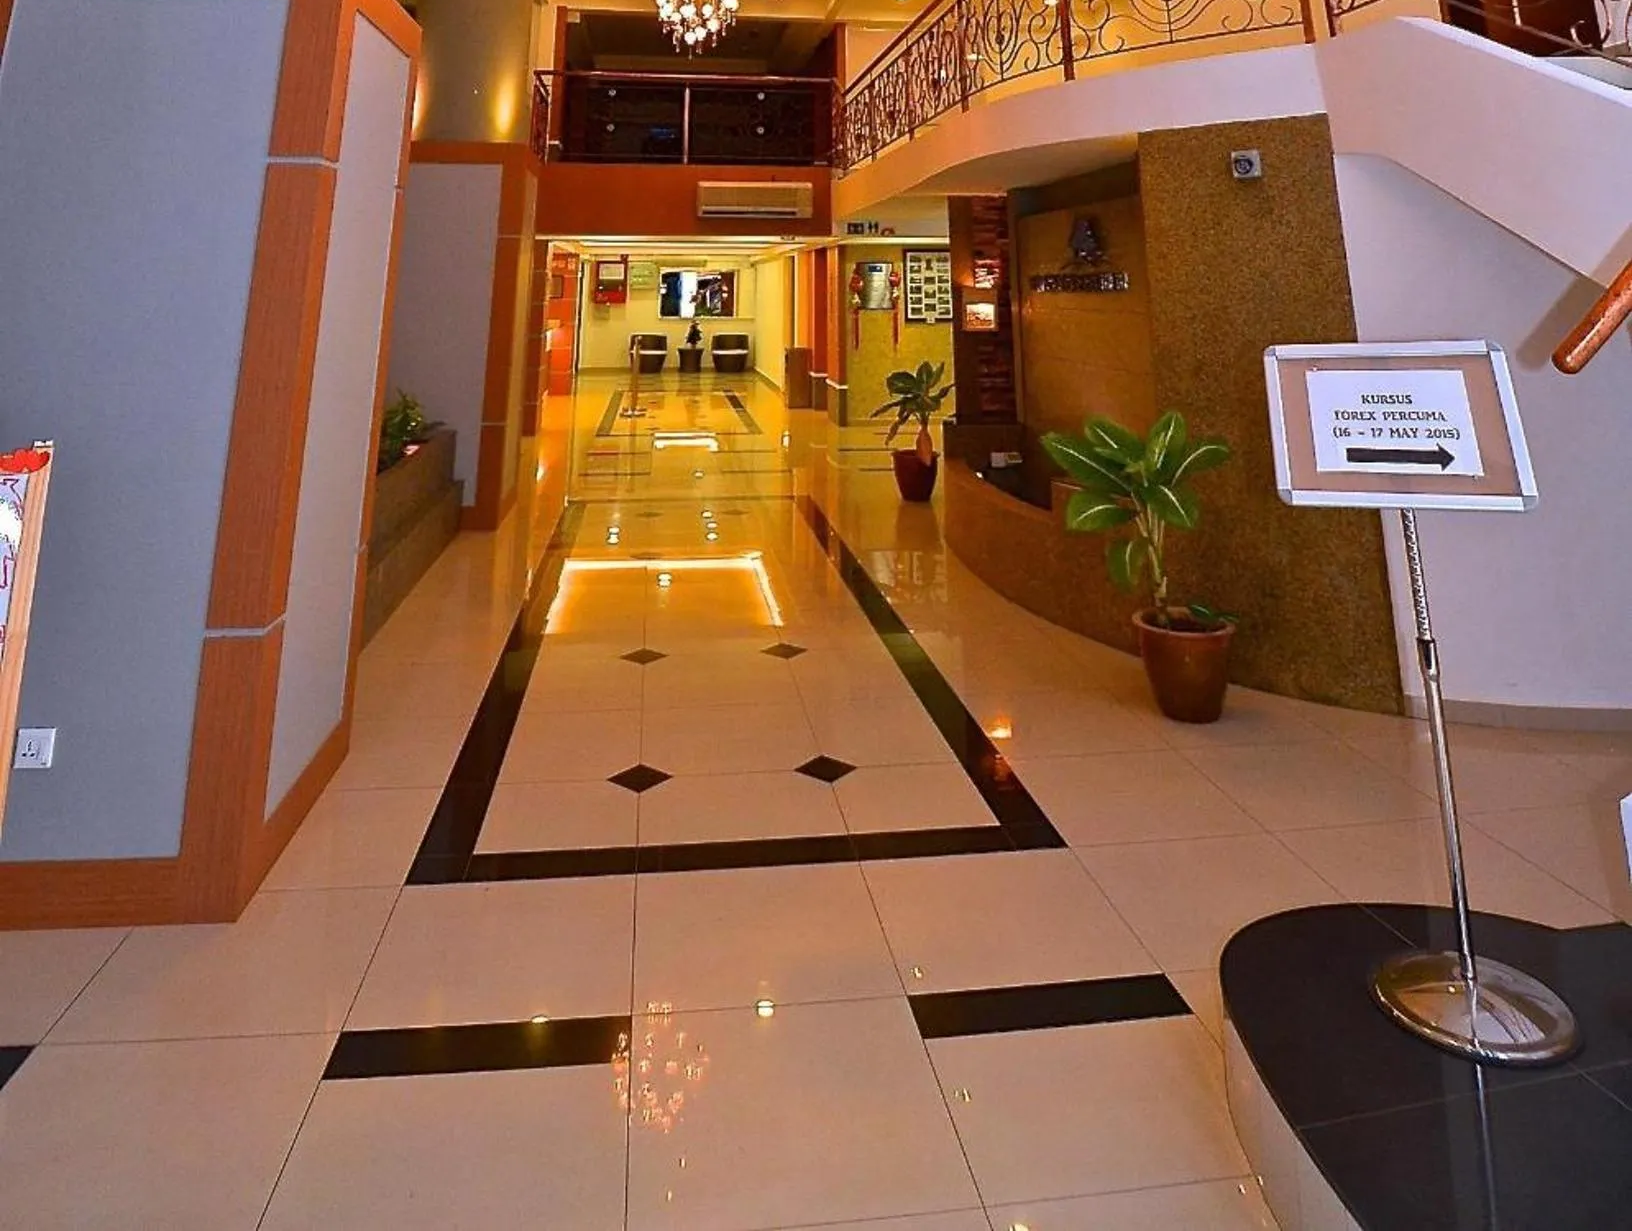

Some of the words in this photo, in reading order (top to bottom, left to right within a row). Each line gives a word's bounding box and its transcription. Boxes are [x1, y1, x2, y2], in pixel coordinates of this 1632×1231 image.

[1360, 394, 1413, 405] KURSUS
[1334, 410, 1377, 421] FOREX
[1382, 410, 1447, 421] PERCUMA
[1333, 427, 1351, 438] (16
[1371, 427, 1384, 438] 17
[1390, 427, 1419, 439] MAY
[1424, 428, 1461, 440] 2015)
